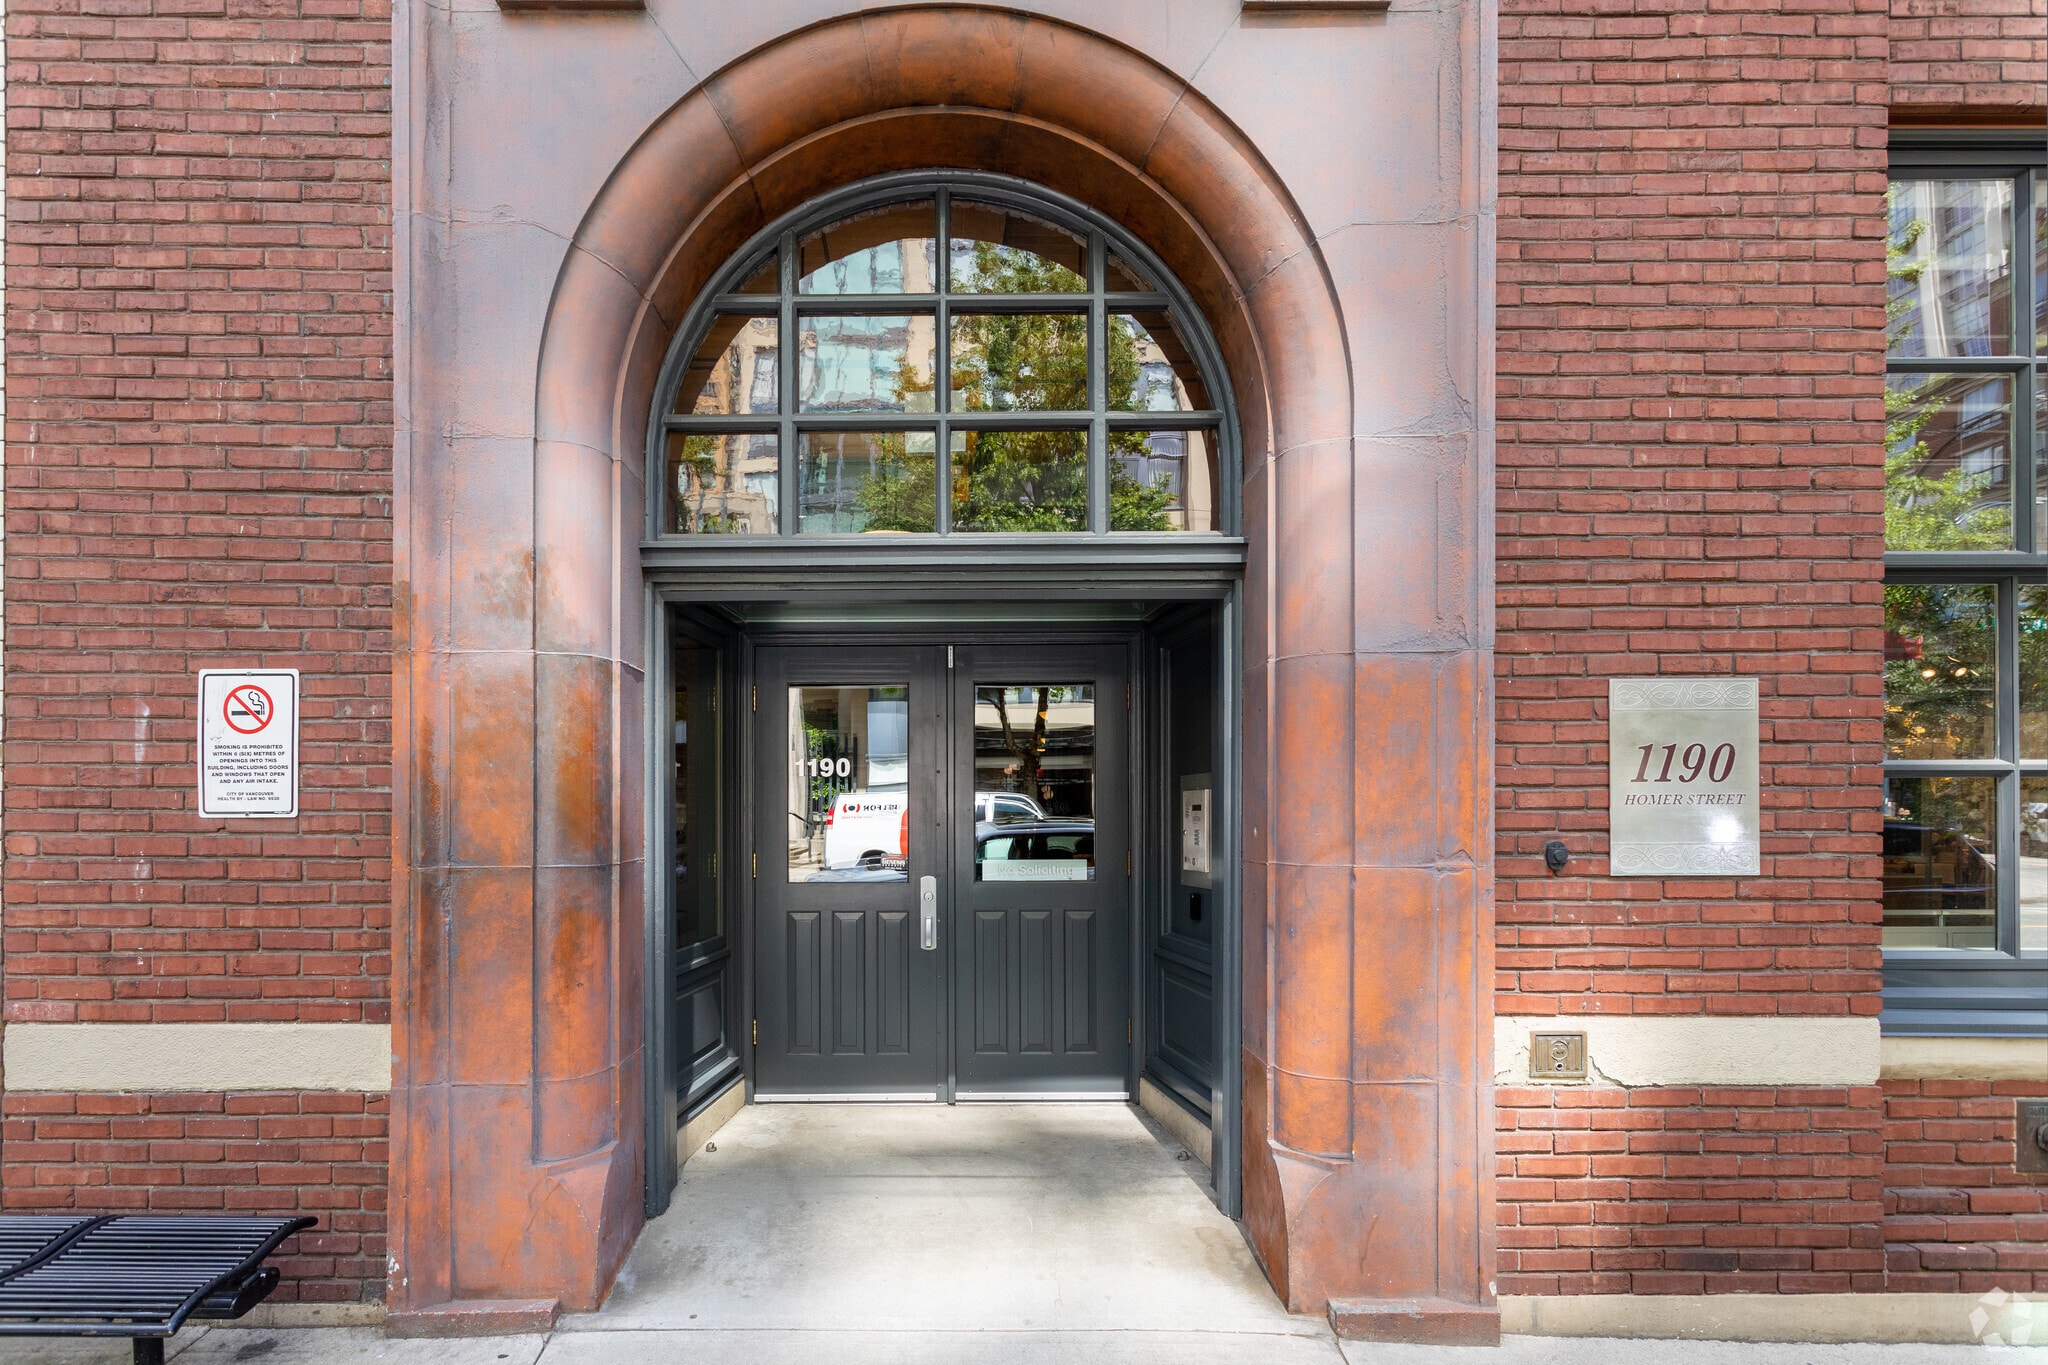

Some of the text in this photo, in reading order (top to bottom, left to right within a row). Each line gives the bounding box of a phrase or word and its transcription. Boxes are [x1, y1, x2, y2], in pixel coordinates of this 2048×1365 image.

[795, 757, 850, 777] 1190
[1630, 743, 1736, 783] 1190
[1624, 793, 1746, 806] HOMER STREET
[997, 864, 1074, 877] No Soliciting
